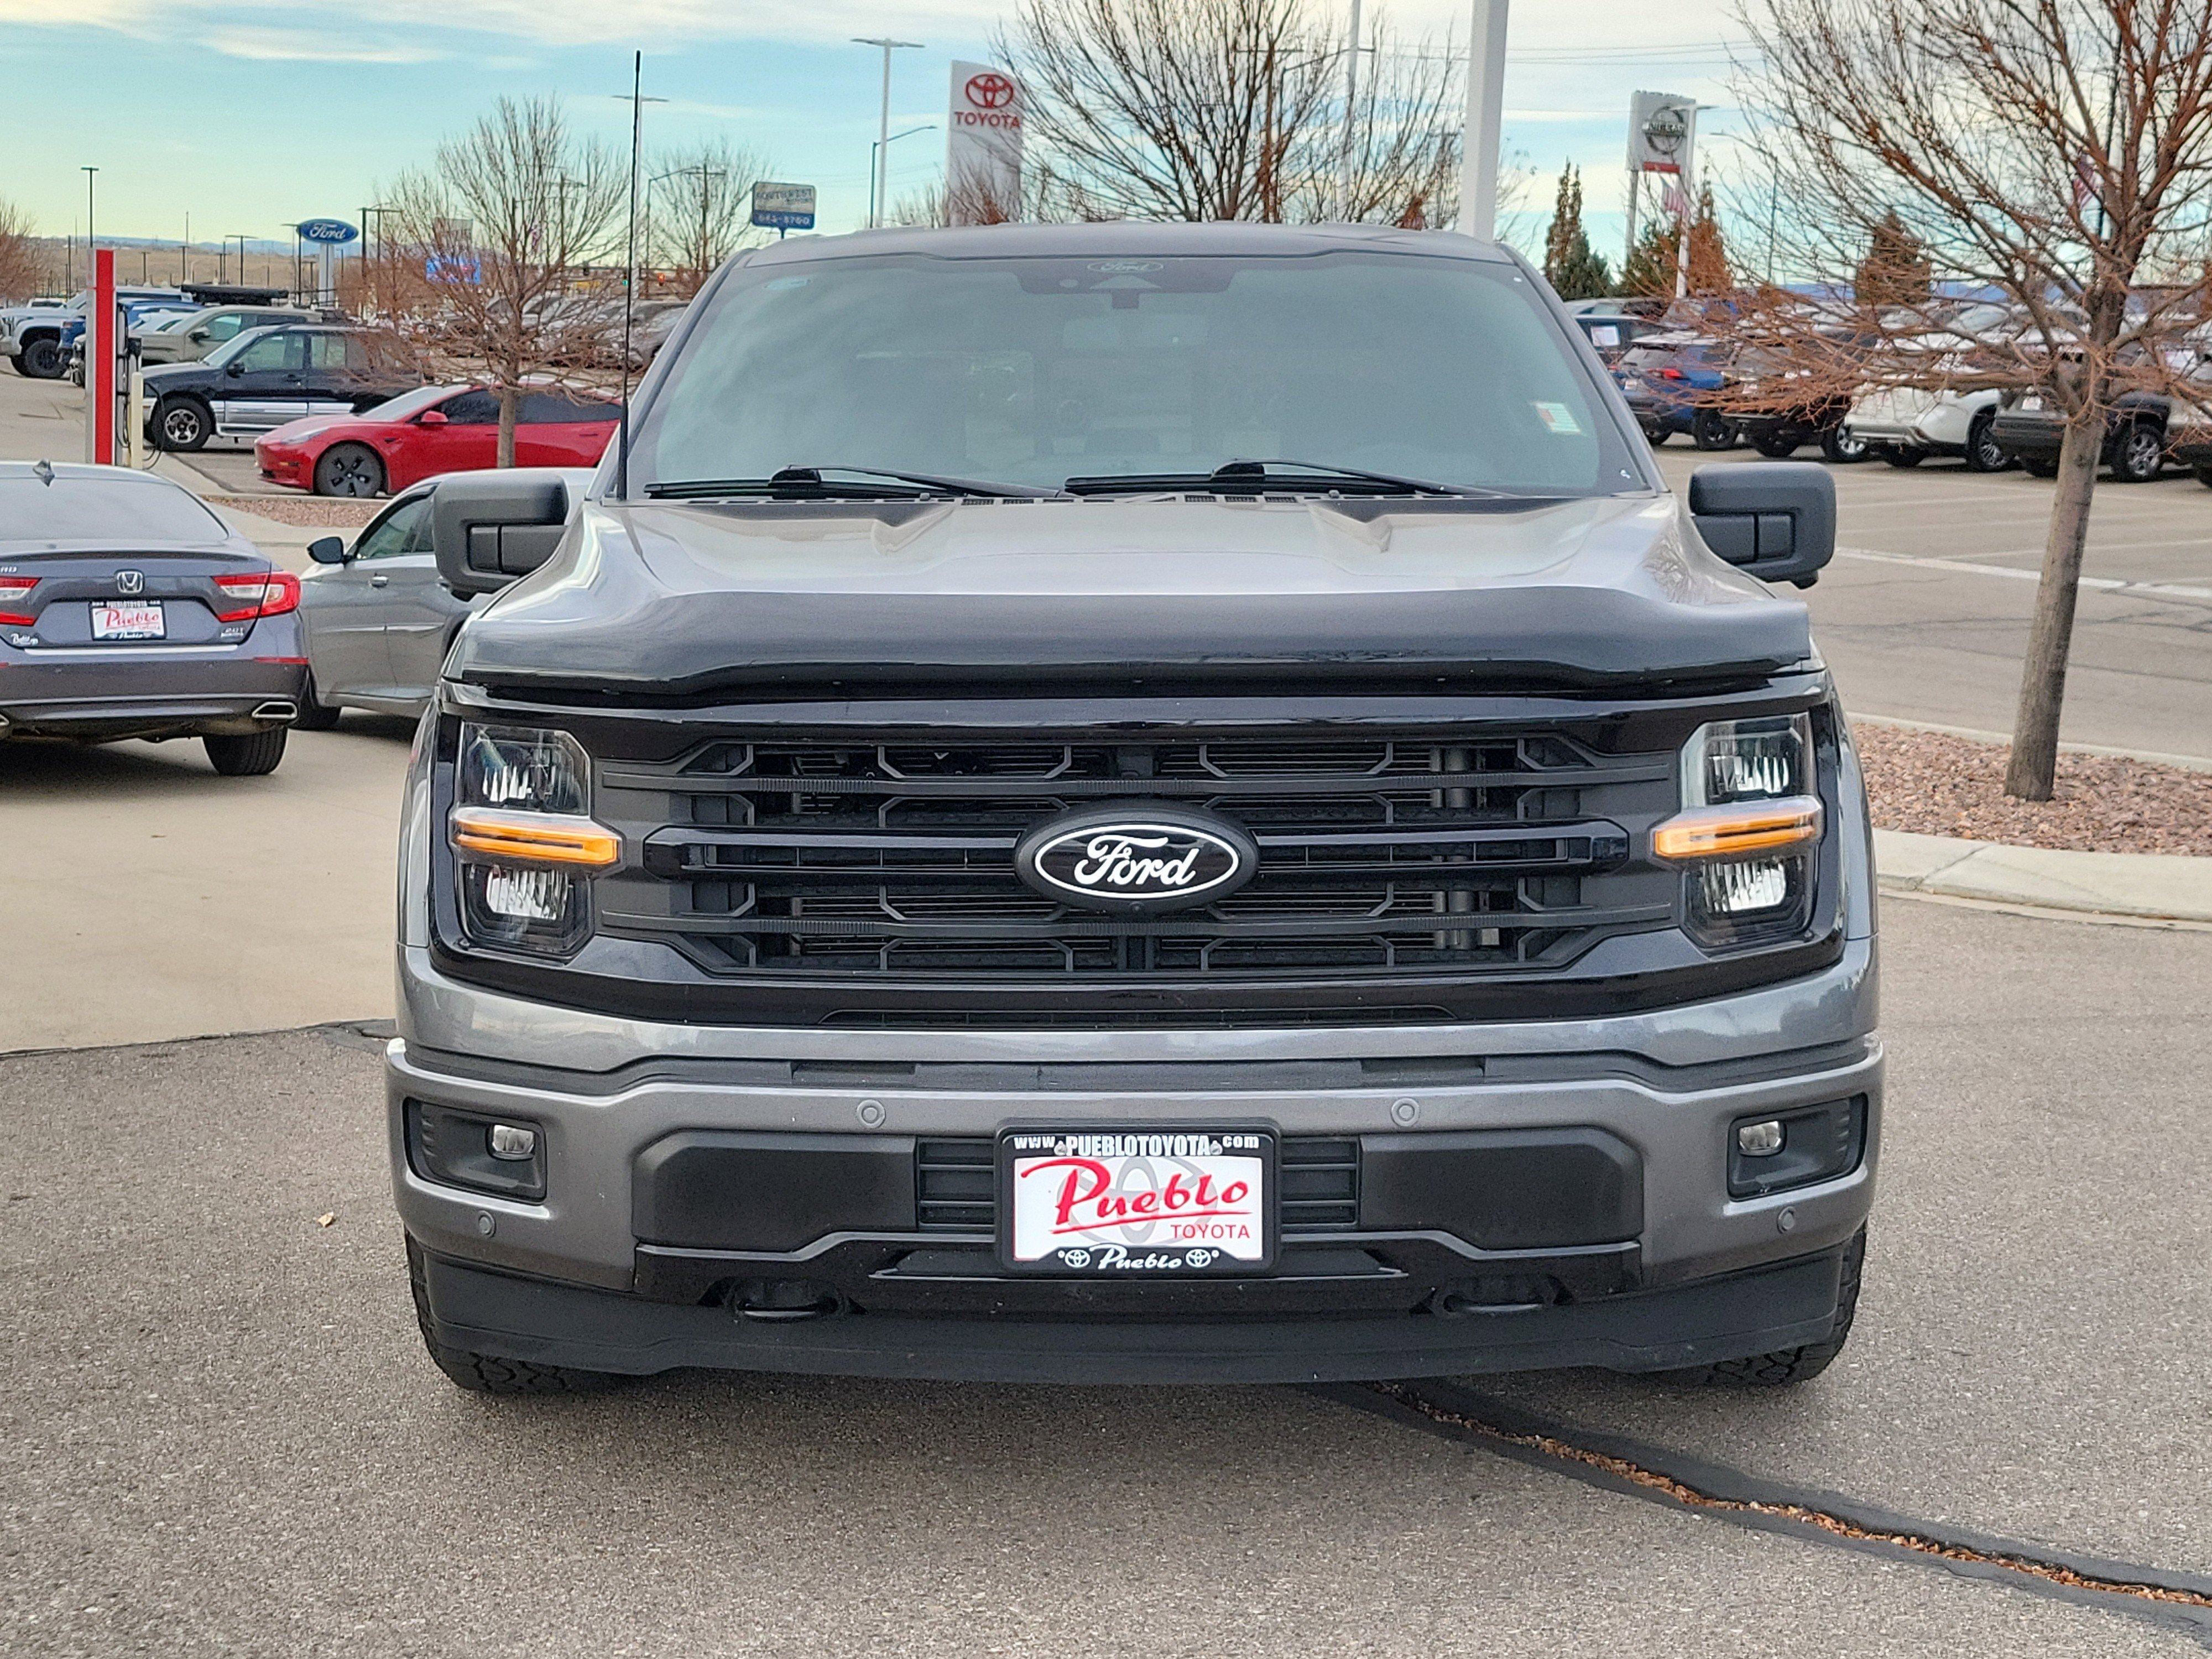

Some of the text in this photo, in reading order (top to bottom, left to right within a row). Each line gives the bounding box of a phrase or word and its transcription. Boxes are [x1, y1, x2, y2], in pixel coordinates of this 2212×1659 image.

[954, 112, 1021, 129] TOYOTA
[309, 223, 347, 239] Ford
[95, 609, 159, 627] Pueblo
[1074, 834, 1199, 885] Ford
[1021, 1158, 1249, 1225] Pueblo
[1170, 1224, 1250, 1239] TOYOTA
[1089, 1244, 1182, 1270] Pueblo
